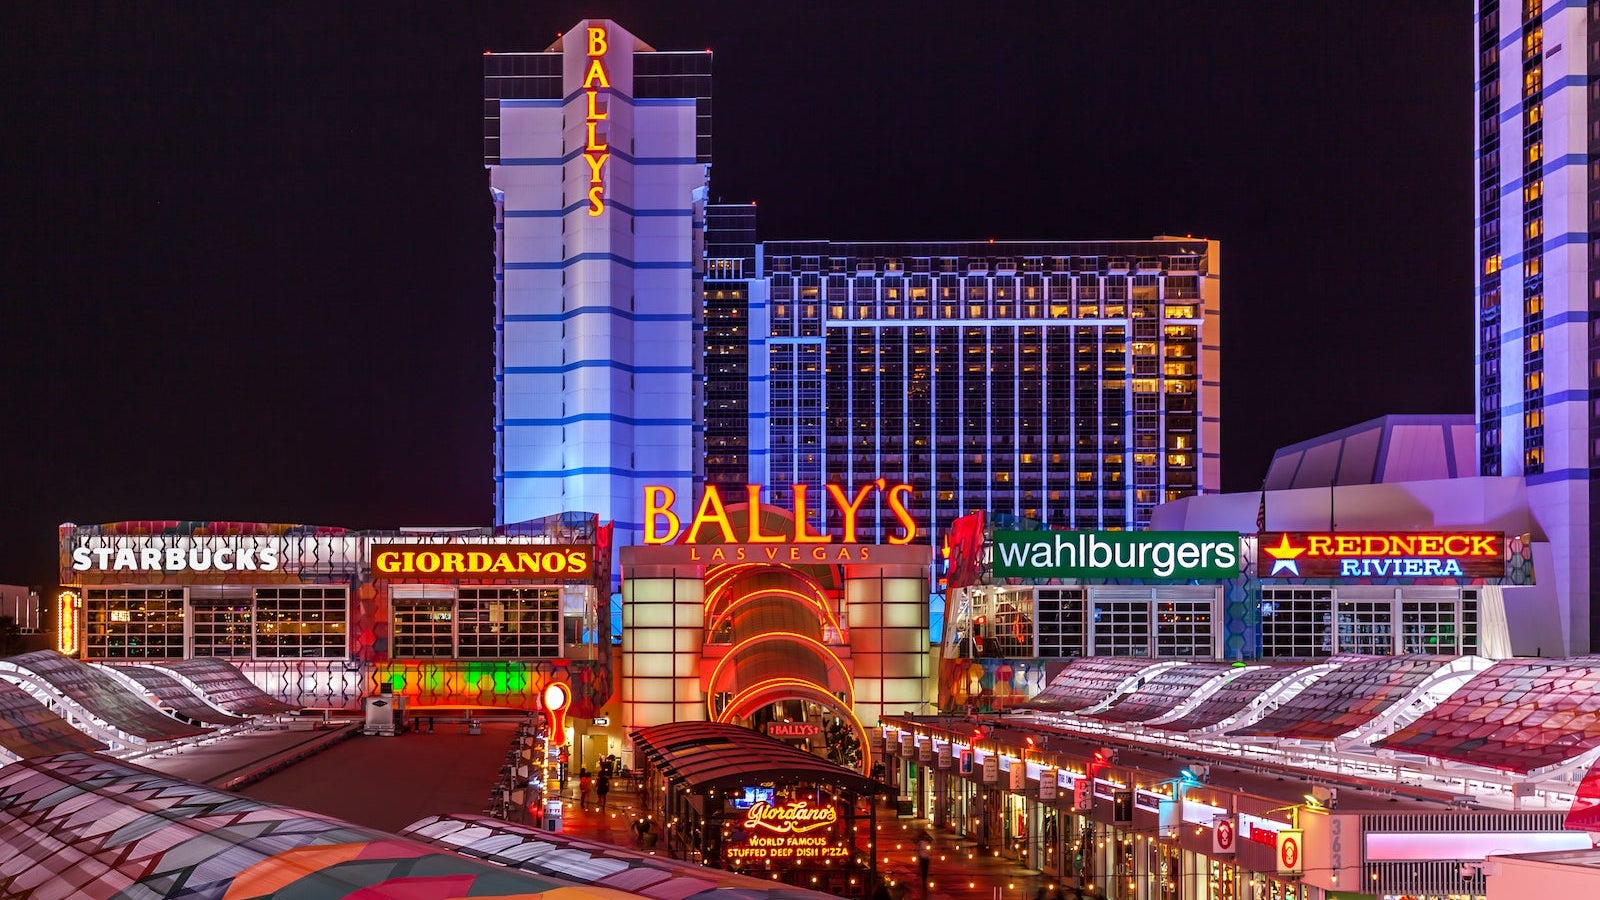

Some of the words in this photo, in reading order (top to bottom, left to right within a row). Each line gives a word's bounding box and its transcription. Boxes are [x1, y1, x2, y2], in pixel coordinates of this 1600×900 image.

[643, 478, 917, 545] BALLY'S
[690, 547, 746, 561] LAS
[765, 547, 872, 561] VEGAS
[998, 534, 1236, 577] wahlburgers
[1307, 535, 1498, 556] REDNECK
[72, 547, 279, 571] STARBUCKS
[375, 548, 588, 573] GIORDANO'S
[1340, 558, 1463, 576] RIVIERA
[775, 725, 813, 735] BALLY'S
[744, 801, 837, 833] Giordano's
[749, 836, 785, 847] WORLD
[787, 837, 827, 847] FAMOUS
[727, 848, 767, 858] STUFFED
[770, 848, 793, 858] DEEP
[796, 848, 819, 857] DISH
[821, 847, 849, 857] PIZZA
